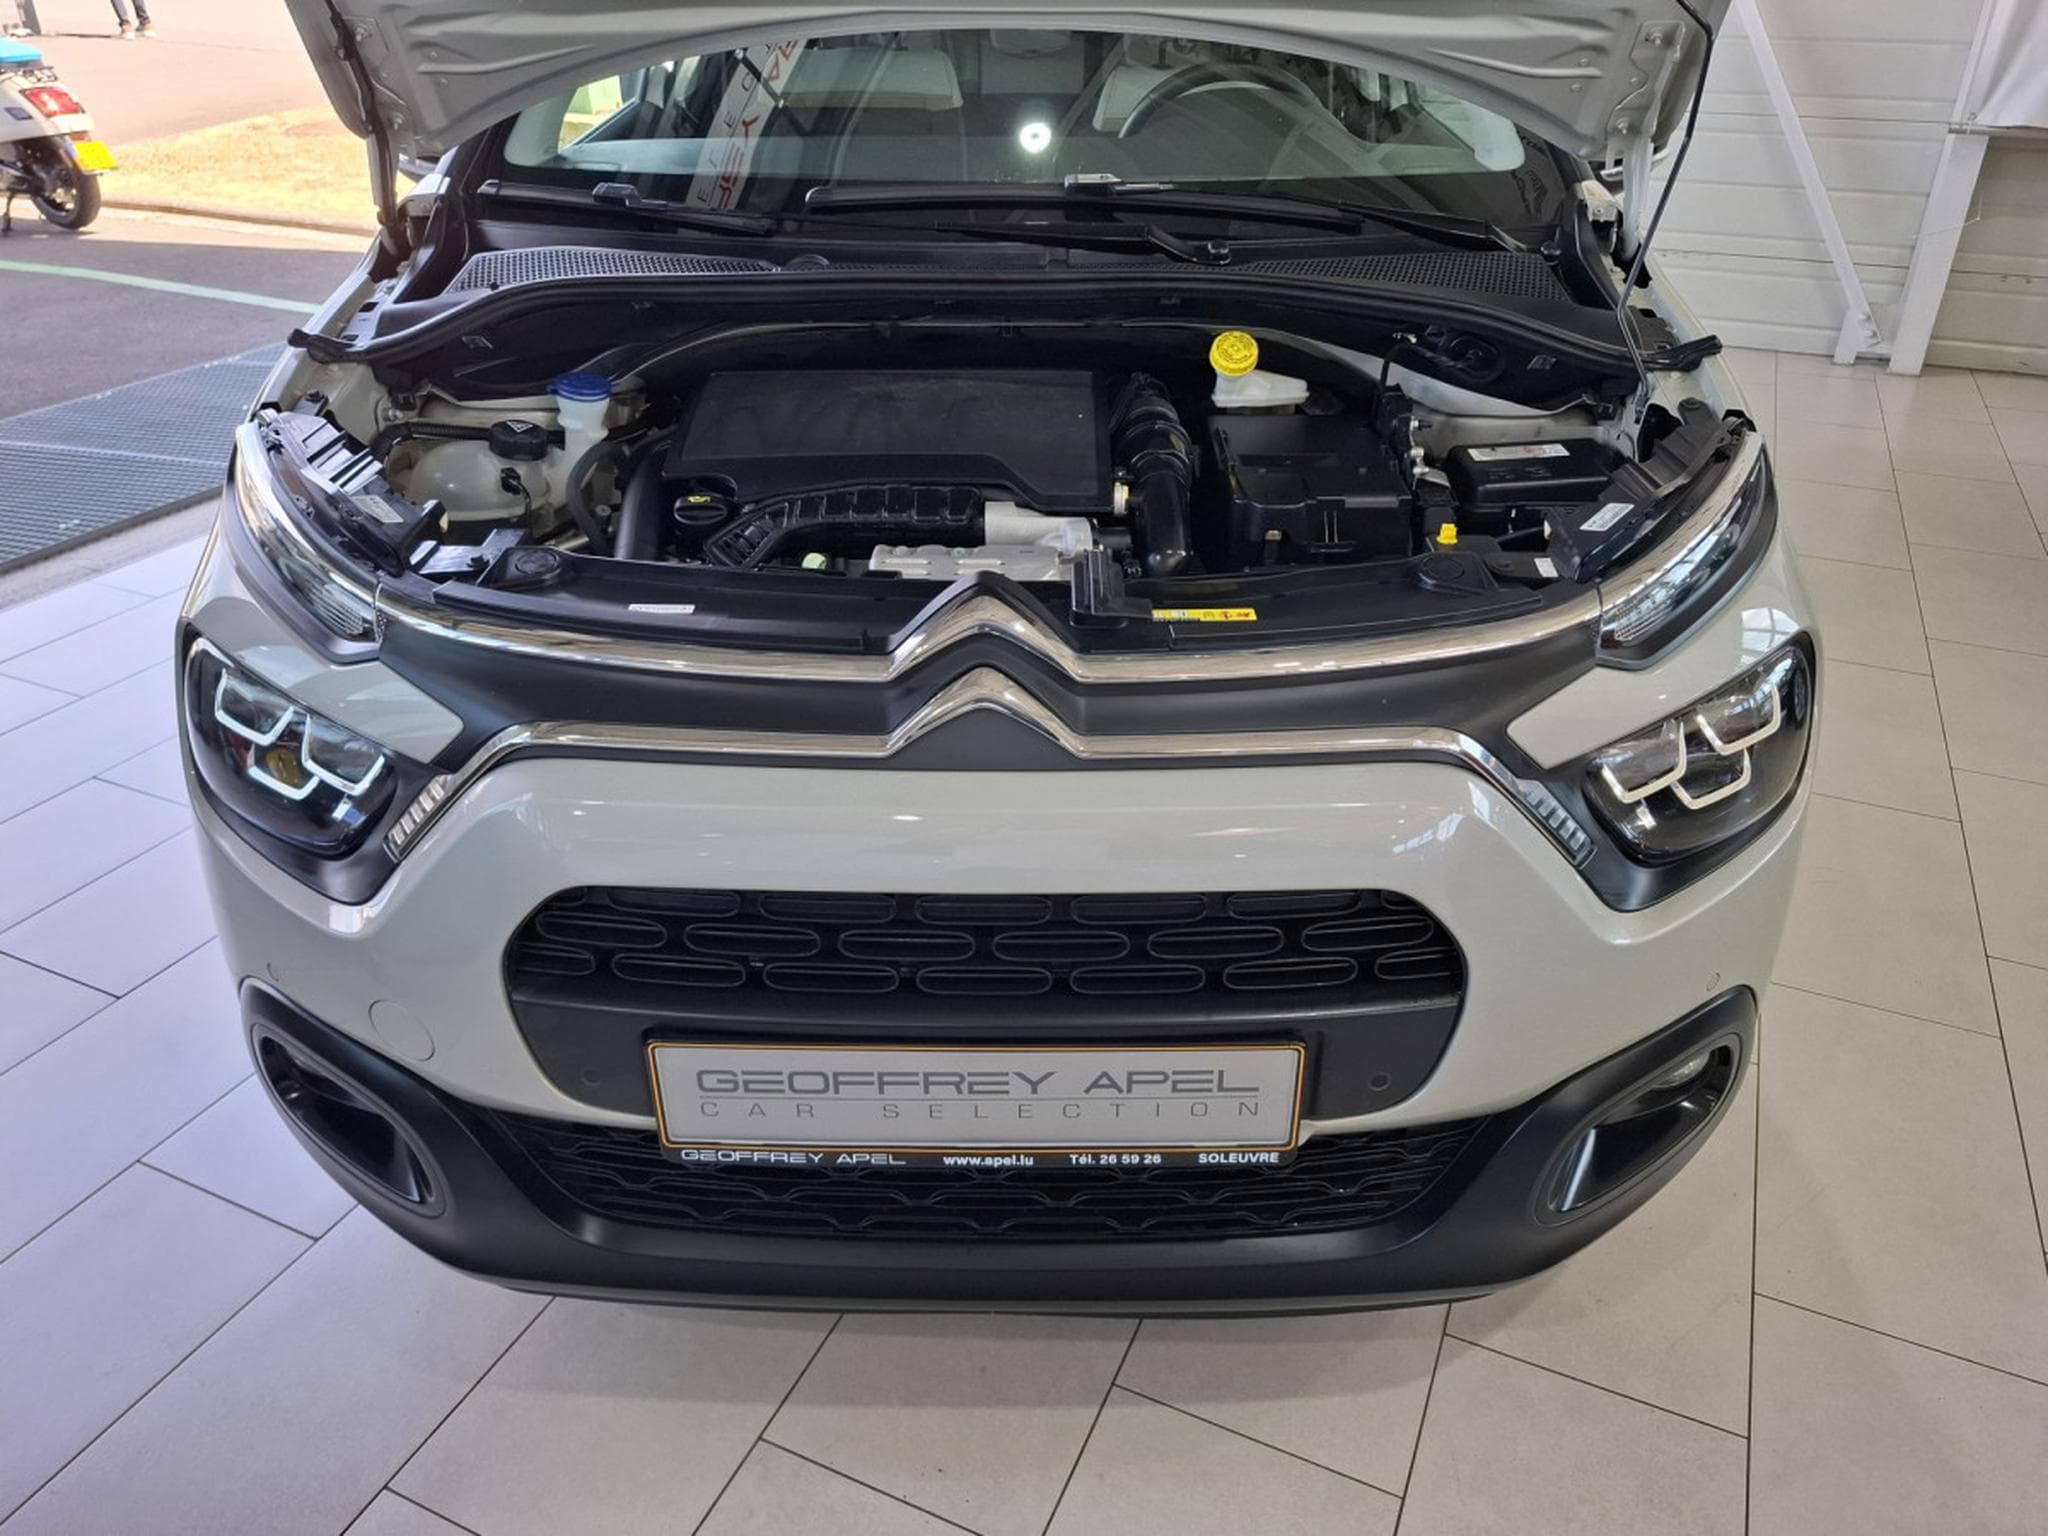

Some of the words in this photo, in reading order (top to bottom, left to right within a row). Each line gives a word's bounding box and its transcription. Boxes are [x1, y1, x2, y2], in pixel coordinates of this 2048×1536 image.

[696, 1069, 1057, 1095] GEOFFREY
[1083, 1069, 1260, 1095] APEL
[700, 1102, 814, 1119] CAR
[882, 1102, 1259, 1119] SELECTION
[681, 1149, 824, 1164] GEOFFREY
[836, 1153, 907, 1165] APEL
[943, 1154, 1034, 1168] www.apel.lu
[1100, 1154, 1118, 1165] 26
[1121, 1154, 1140, 1165] 59
[1144, 1154, 1162, 1165] 26
[1198, 1152, 1279, 1164] SOLEUVRE
